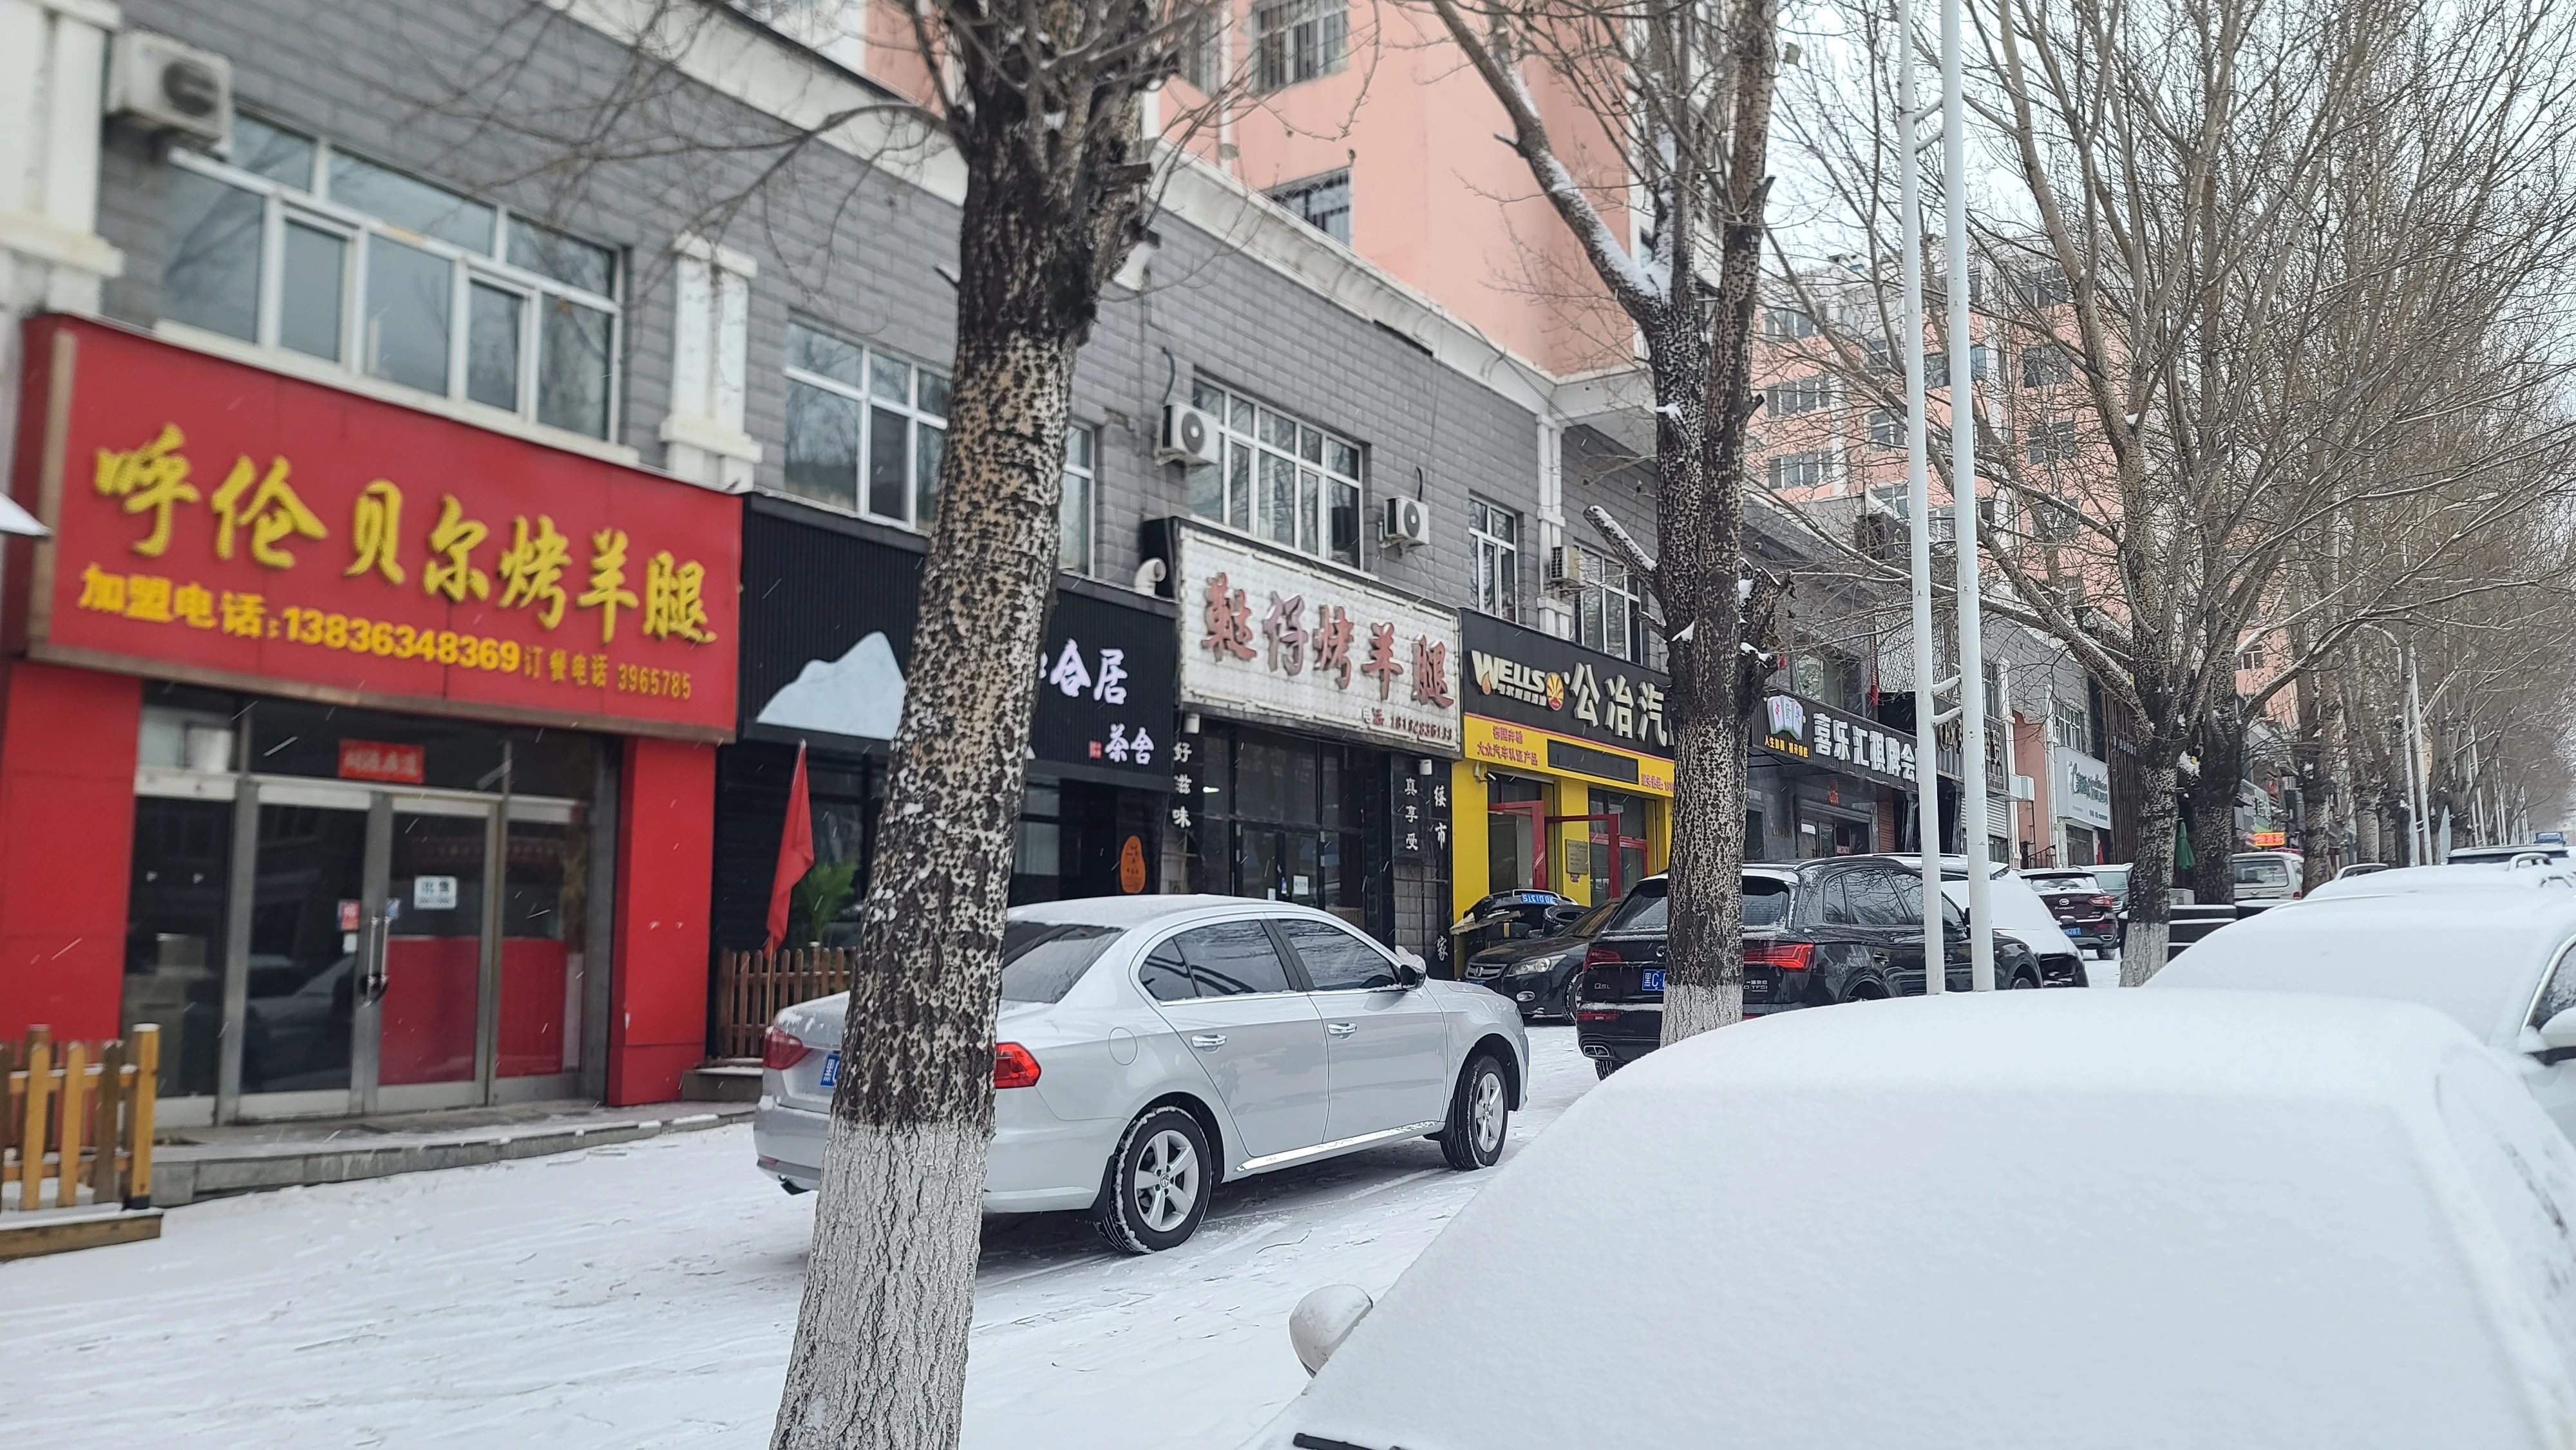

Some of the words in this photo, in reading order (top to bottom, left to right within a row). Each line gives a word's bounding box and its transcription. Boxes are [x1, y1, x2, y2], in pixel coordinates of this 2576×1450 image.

[94, 422, 717, 644] 呼伦贝尔烤羊腿
[618, 663, 692, 700] 3965785
[1038, 637, 1128, 704] 合居
[1471, 650, 1546, 695] WELLS
[1570, 662, 1674, 748] 公冶汽
[1104, 723, 1155, 765] 茶舍
[1477, 741, 1538, 766] 大众汽车认证产品
[1814, 713, 1918, 784] 喜乐汇棋牌会
[1172, 741, 1193, 829] 好滋味
[1405, 777, 1419, 852] 真享受
[1644, 972, 1667, 987] 黑C
